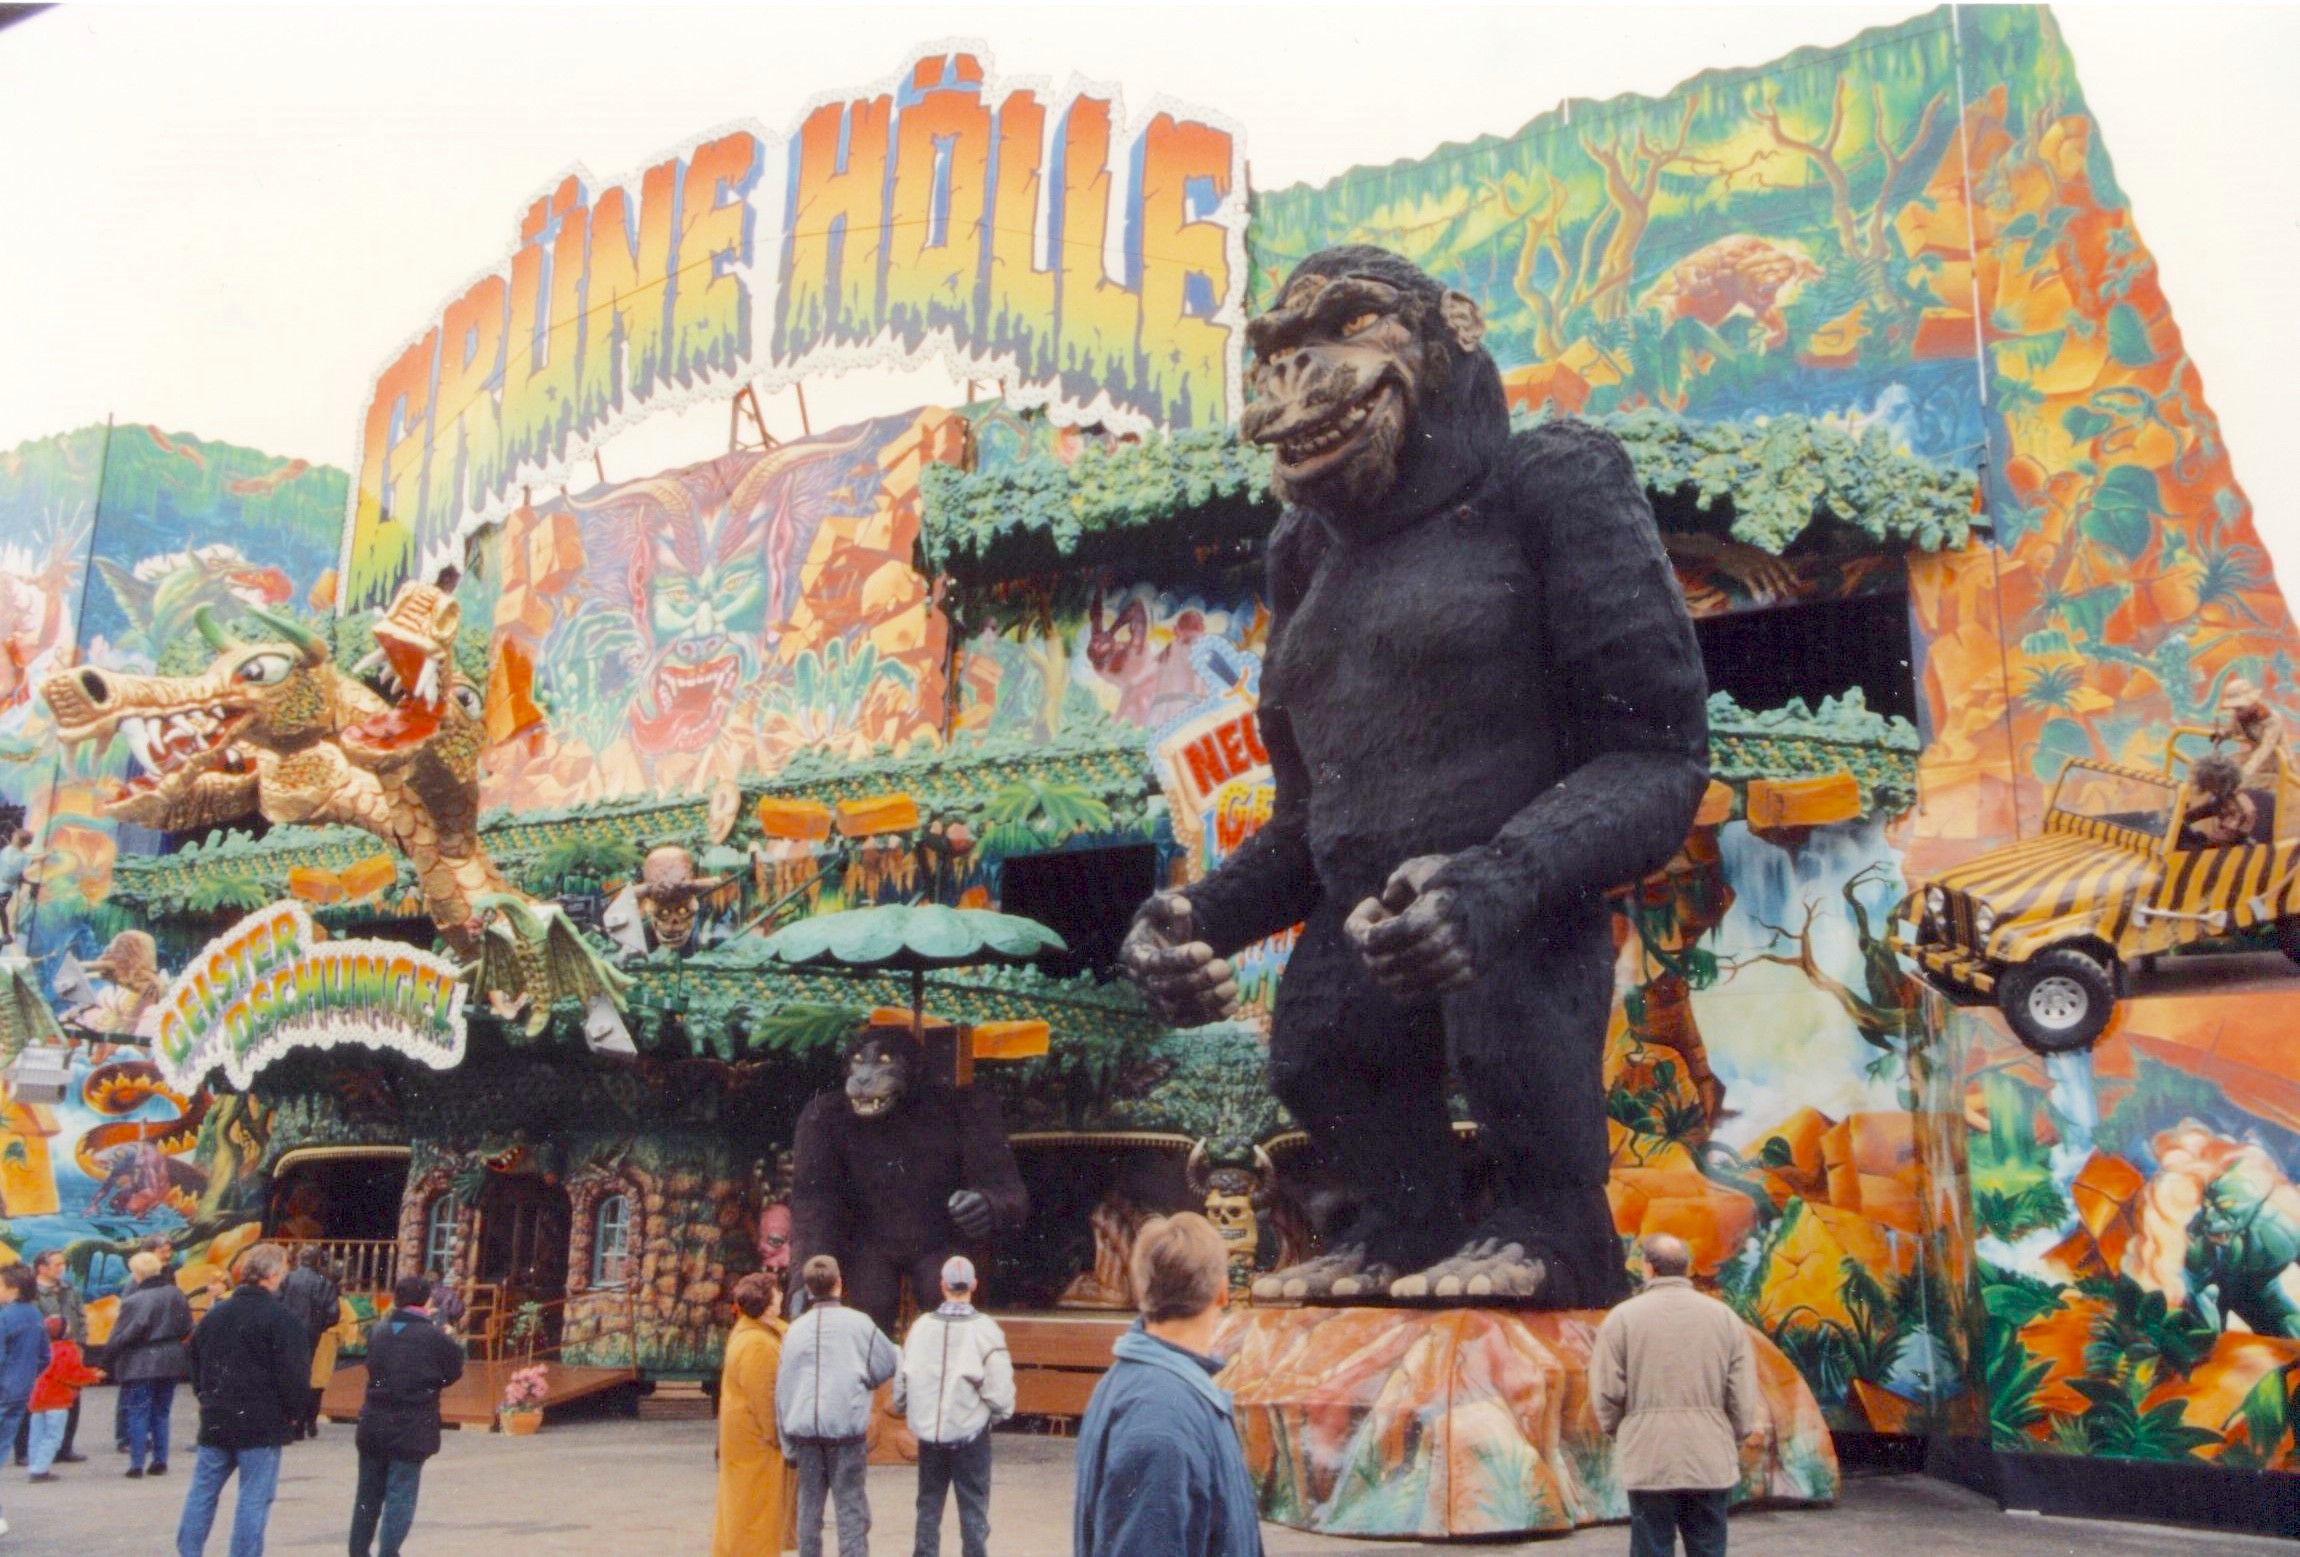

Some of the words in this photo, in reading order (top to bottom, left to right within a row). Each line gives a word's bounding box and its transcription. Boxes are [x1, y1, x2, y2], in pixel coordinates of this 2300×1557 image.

[347, 131, 765, 615] GRÜNE
[774, 53, 1234, 430] HÖLLE
[160, 911, 305, 1068] GEISTER
[223, 953, 458, 1060] DSCHUNGEL
